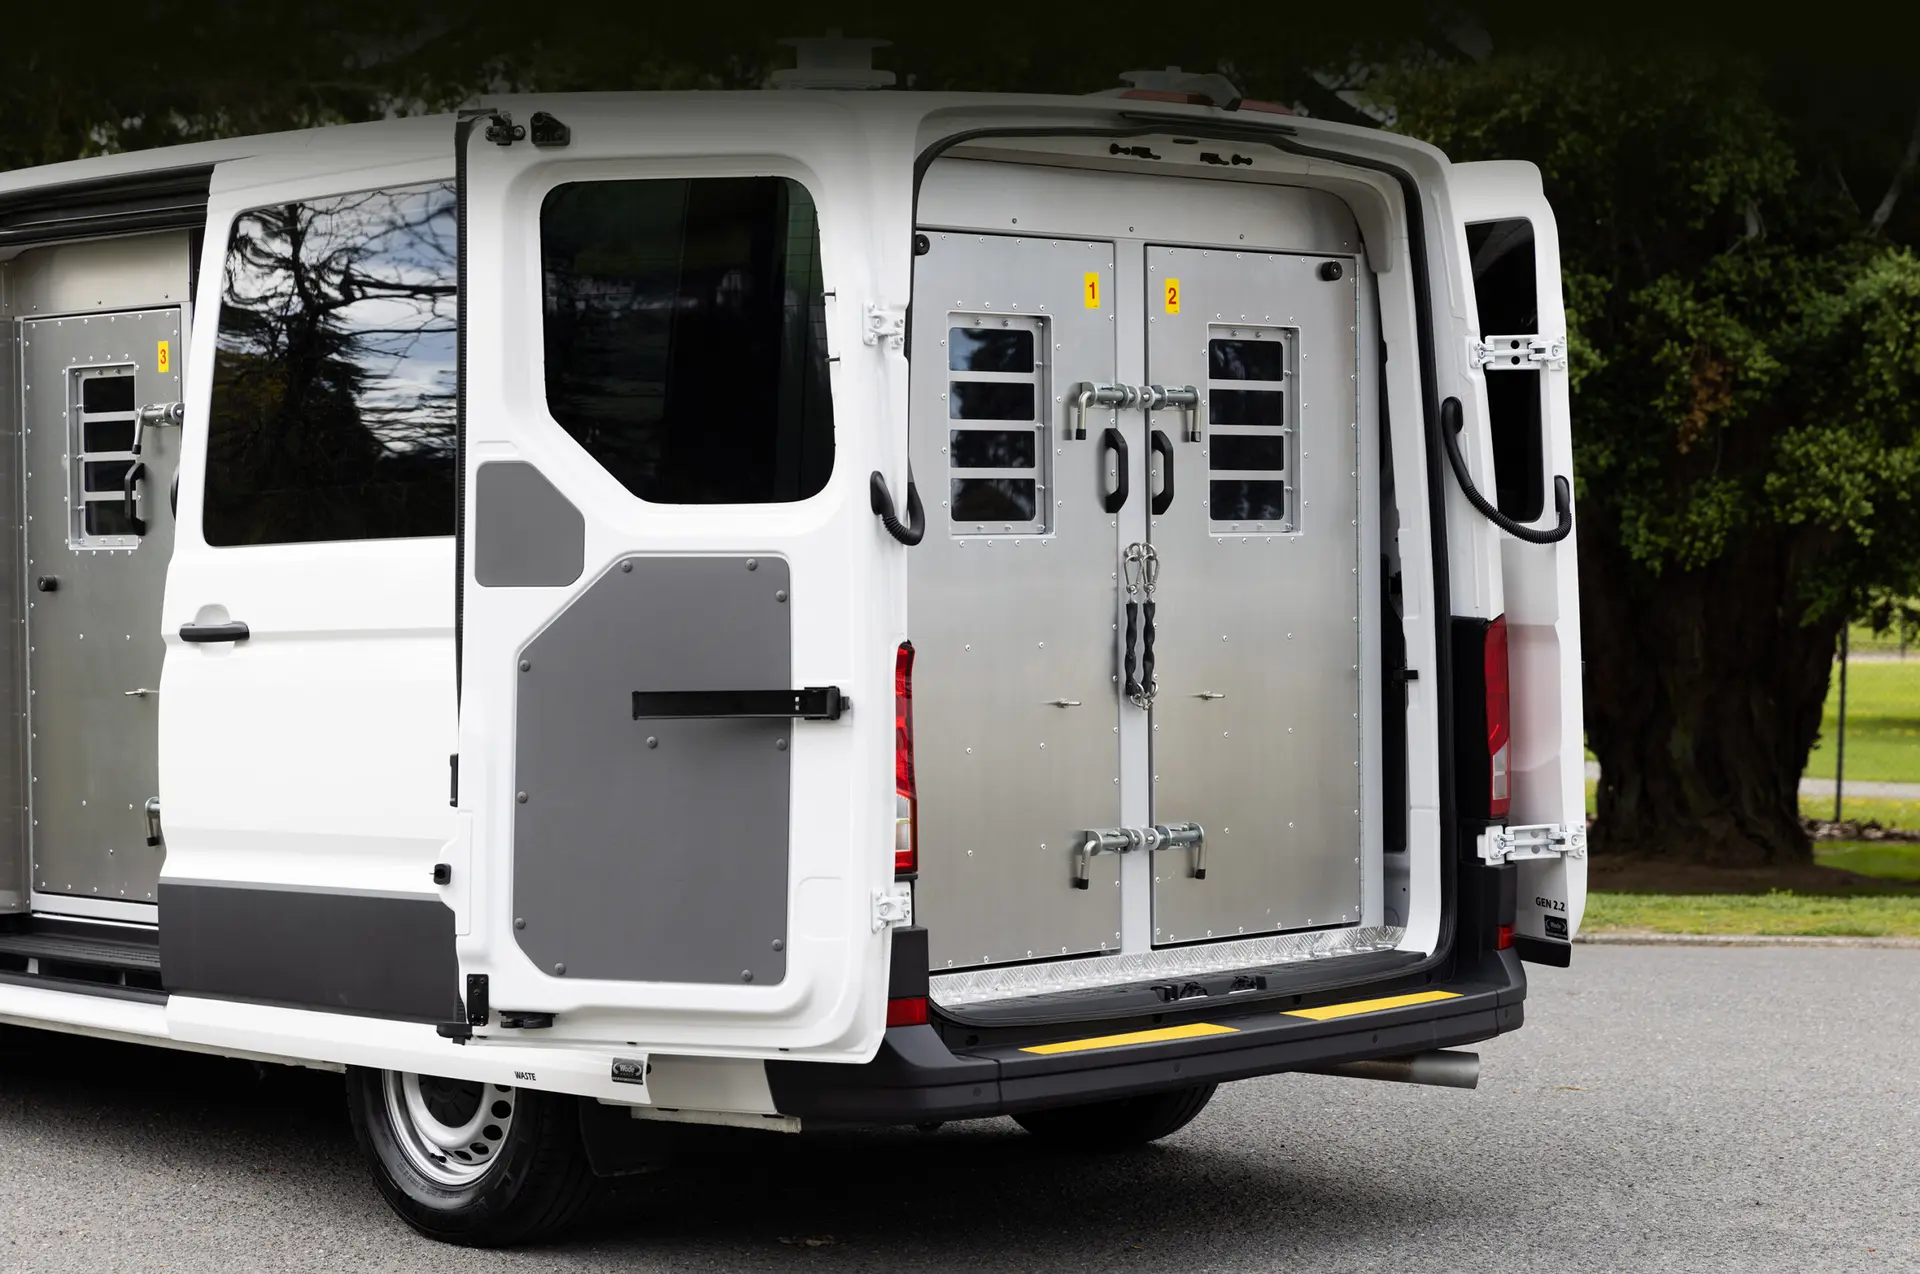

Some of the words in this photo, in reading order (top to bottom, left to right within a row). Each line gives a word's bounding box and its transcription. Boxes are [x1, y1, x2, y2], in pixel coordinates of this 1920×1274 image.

[1088, 281, 1095, 300] 1
[1168, 287, 1177, 305] 2
[160, 348, 167, 365] 3
[1535, 896, 1552, 909] GEN
[1553, 900, 1565, 912] 2.2
[514, 1070, 536, 1081] WASTE
